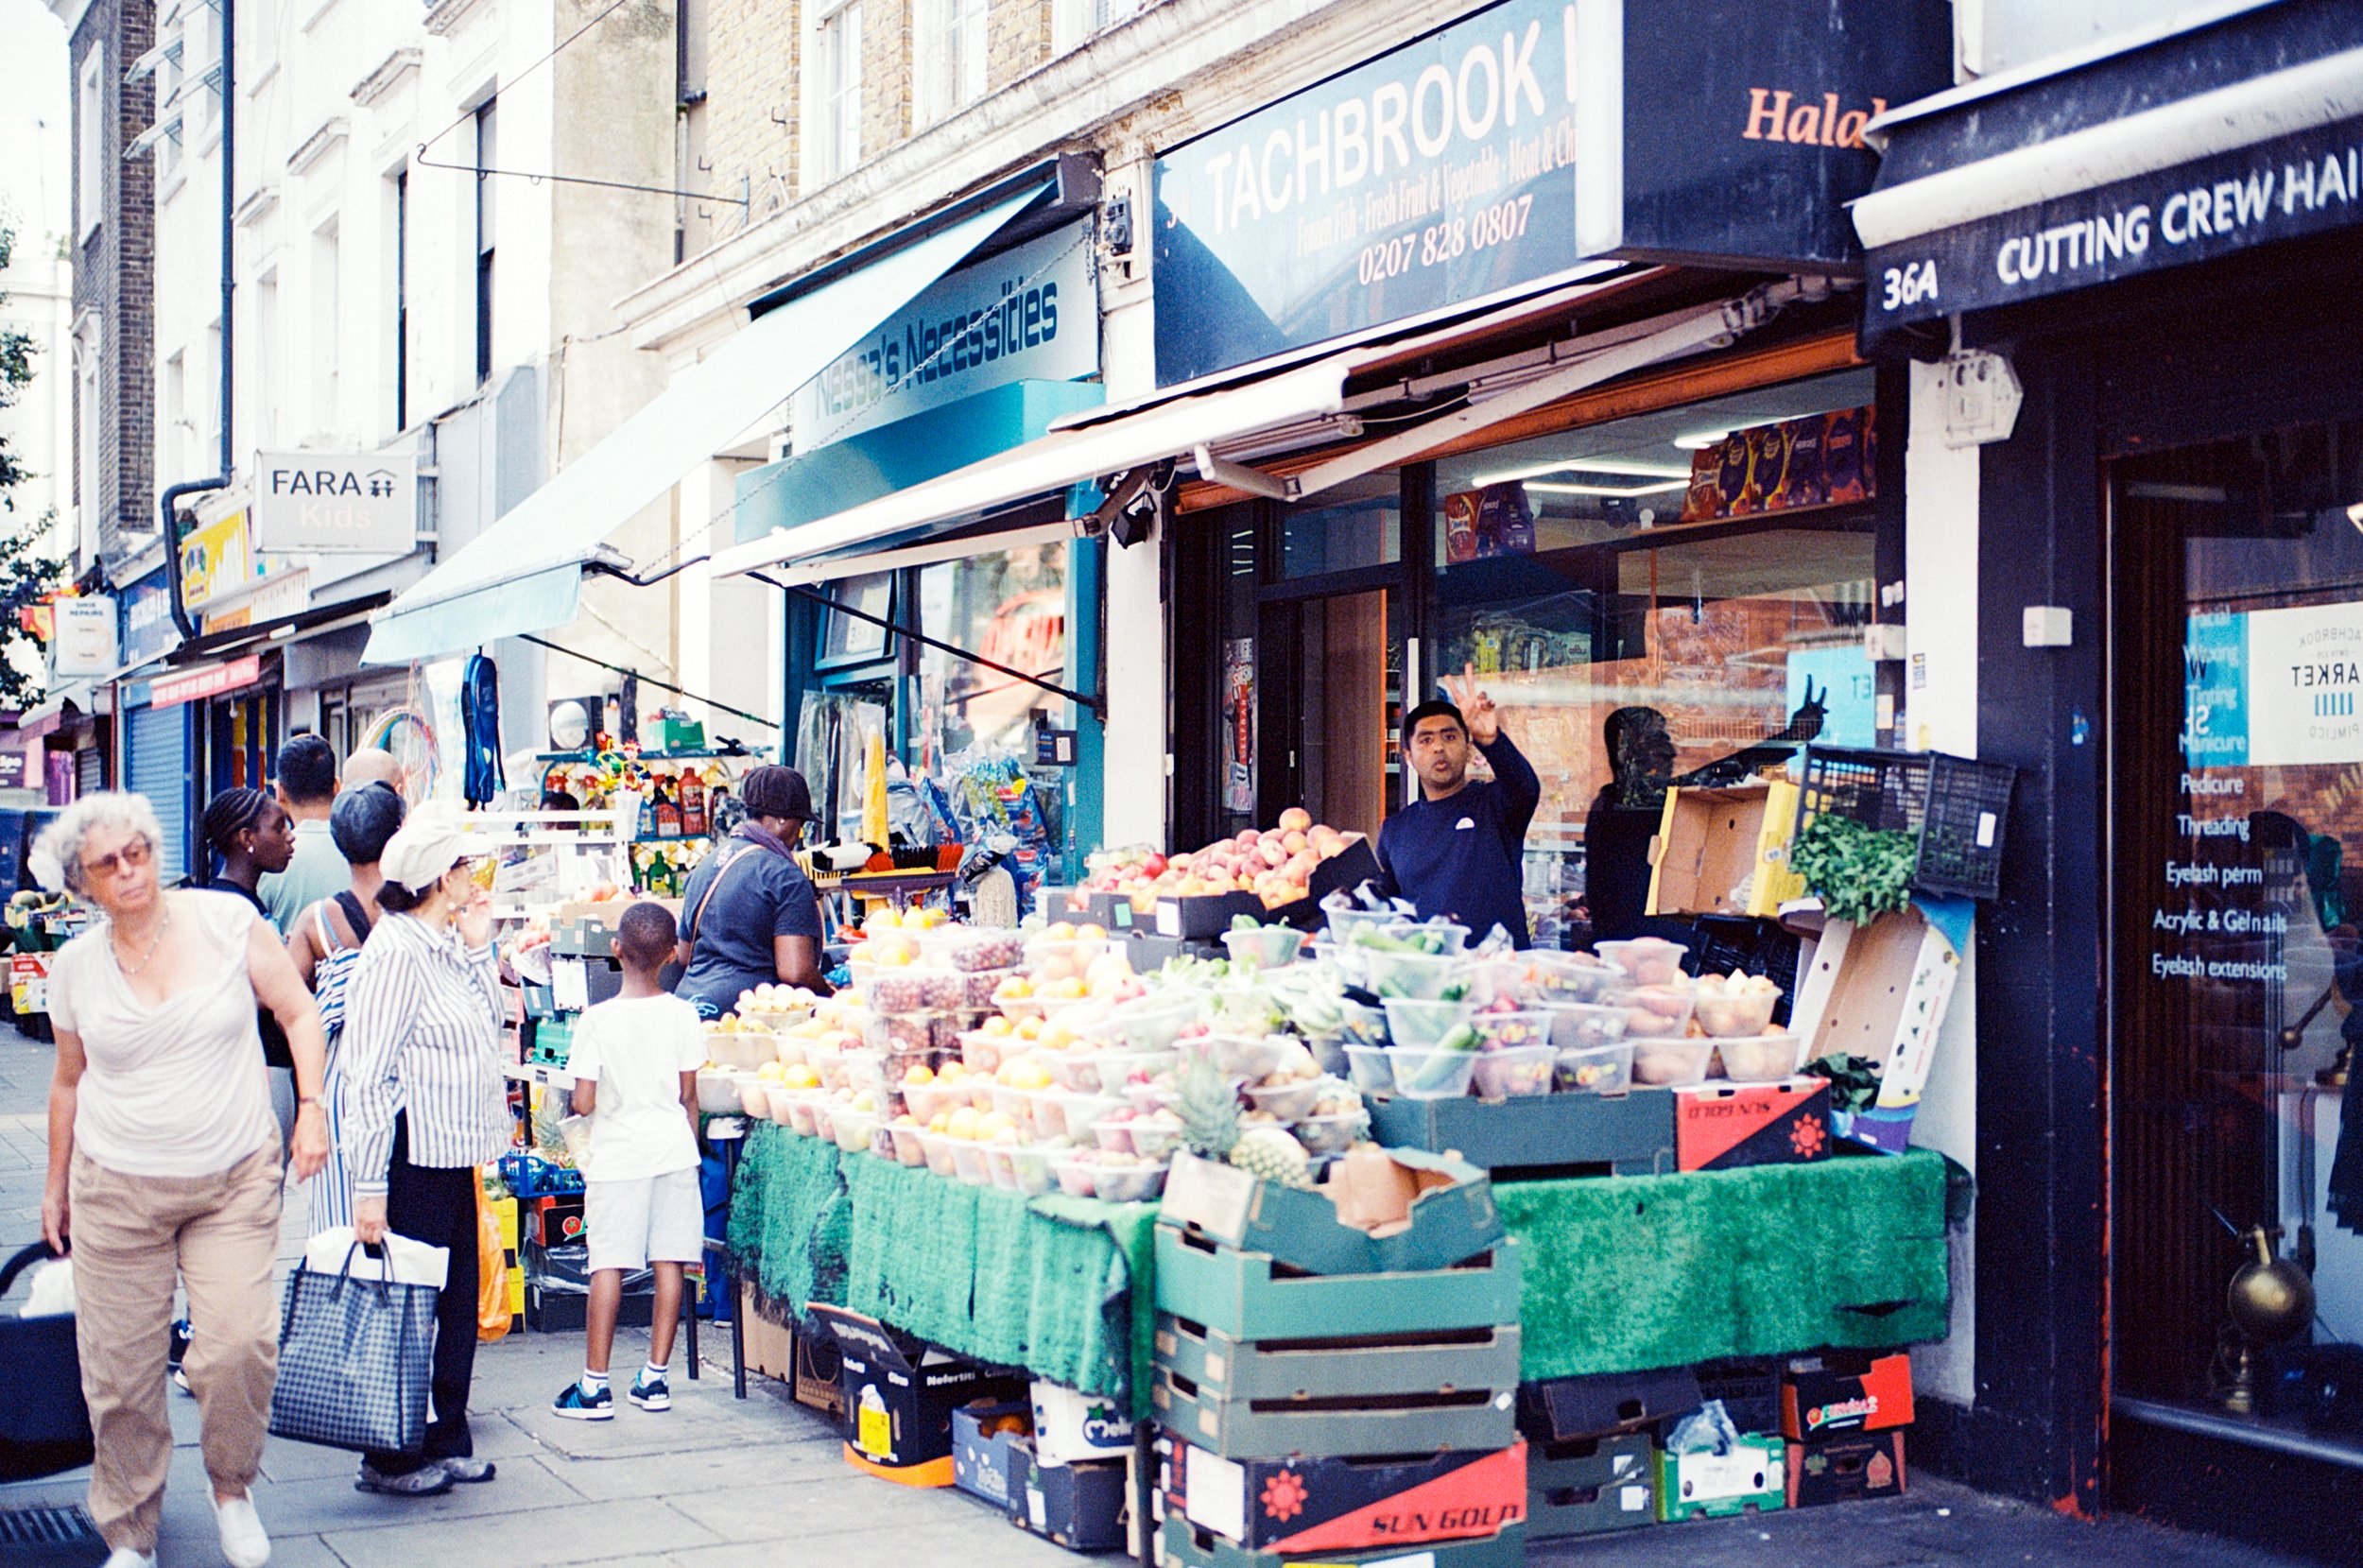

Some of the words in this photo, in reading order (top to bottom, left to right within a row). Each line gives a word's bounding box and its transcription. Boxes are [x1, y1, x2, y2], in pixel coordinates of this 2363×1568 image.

[1205, 20, 1545, 235] TACHBROOK
[1335, 197, 1356, 243] Fish
[1365, 181, 1397, 233] Fresh
[1398, 172, 1427, 222] Fruit
[1429, 167, 1440, 213] &
[1443, 145, 1499, 214] Vegetable
[1509, 135, 1540, 184] Meat
[1542, 125, 1553, 173] &
[1359, 233, 1417, 286] 0207
[1422, 217, 1465, 267] 828
[1472, 194, 1533, 250] 0807
[1883, 260, 1939, 312] 36A
[1996, 205, 2150, 284] CUTTING
[2160, 168, 2275, 245] CREW
[2284, 146, 2363, 215] HAI
[905, 276, 1058, 389] Necessities
[272, 470, 362, 496] FARA
[301, 502, 371, 530] Kids
[2179, 732, 2247, 753] Manicure
[2181, 773, 2245, 795] Pedicure
[2177, 814, 2251, 842] Threading
[2165, 861, 2218, 887] Eyelash
[2222, 867, 2263, 888] perm
[2152, 909, 2203, 936] Acrylic
[2207, 909, 2220, 931] &
[2152, 953, 2205, 980] Eyelash
[2208, 959, 2287, 981] extensions
[1373, 1513, 1434, 1533] SUN
[1440, 1505, 1519, 1529] GOLD
